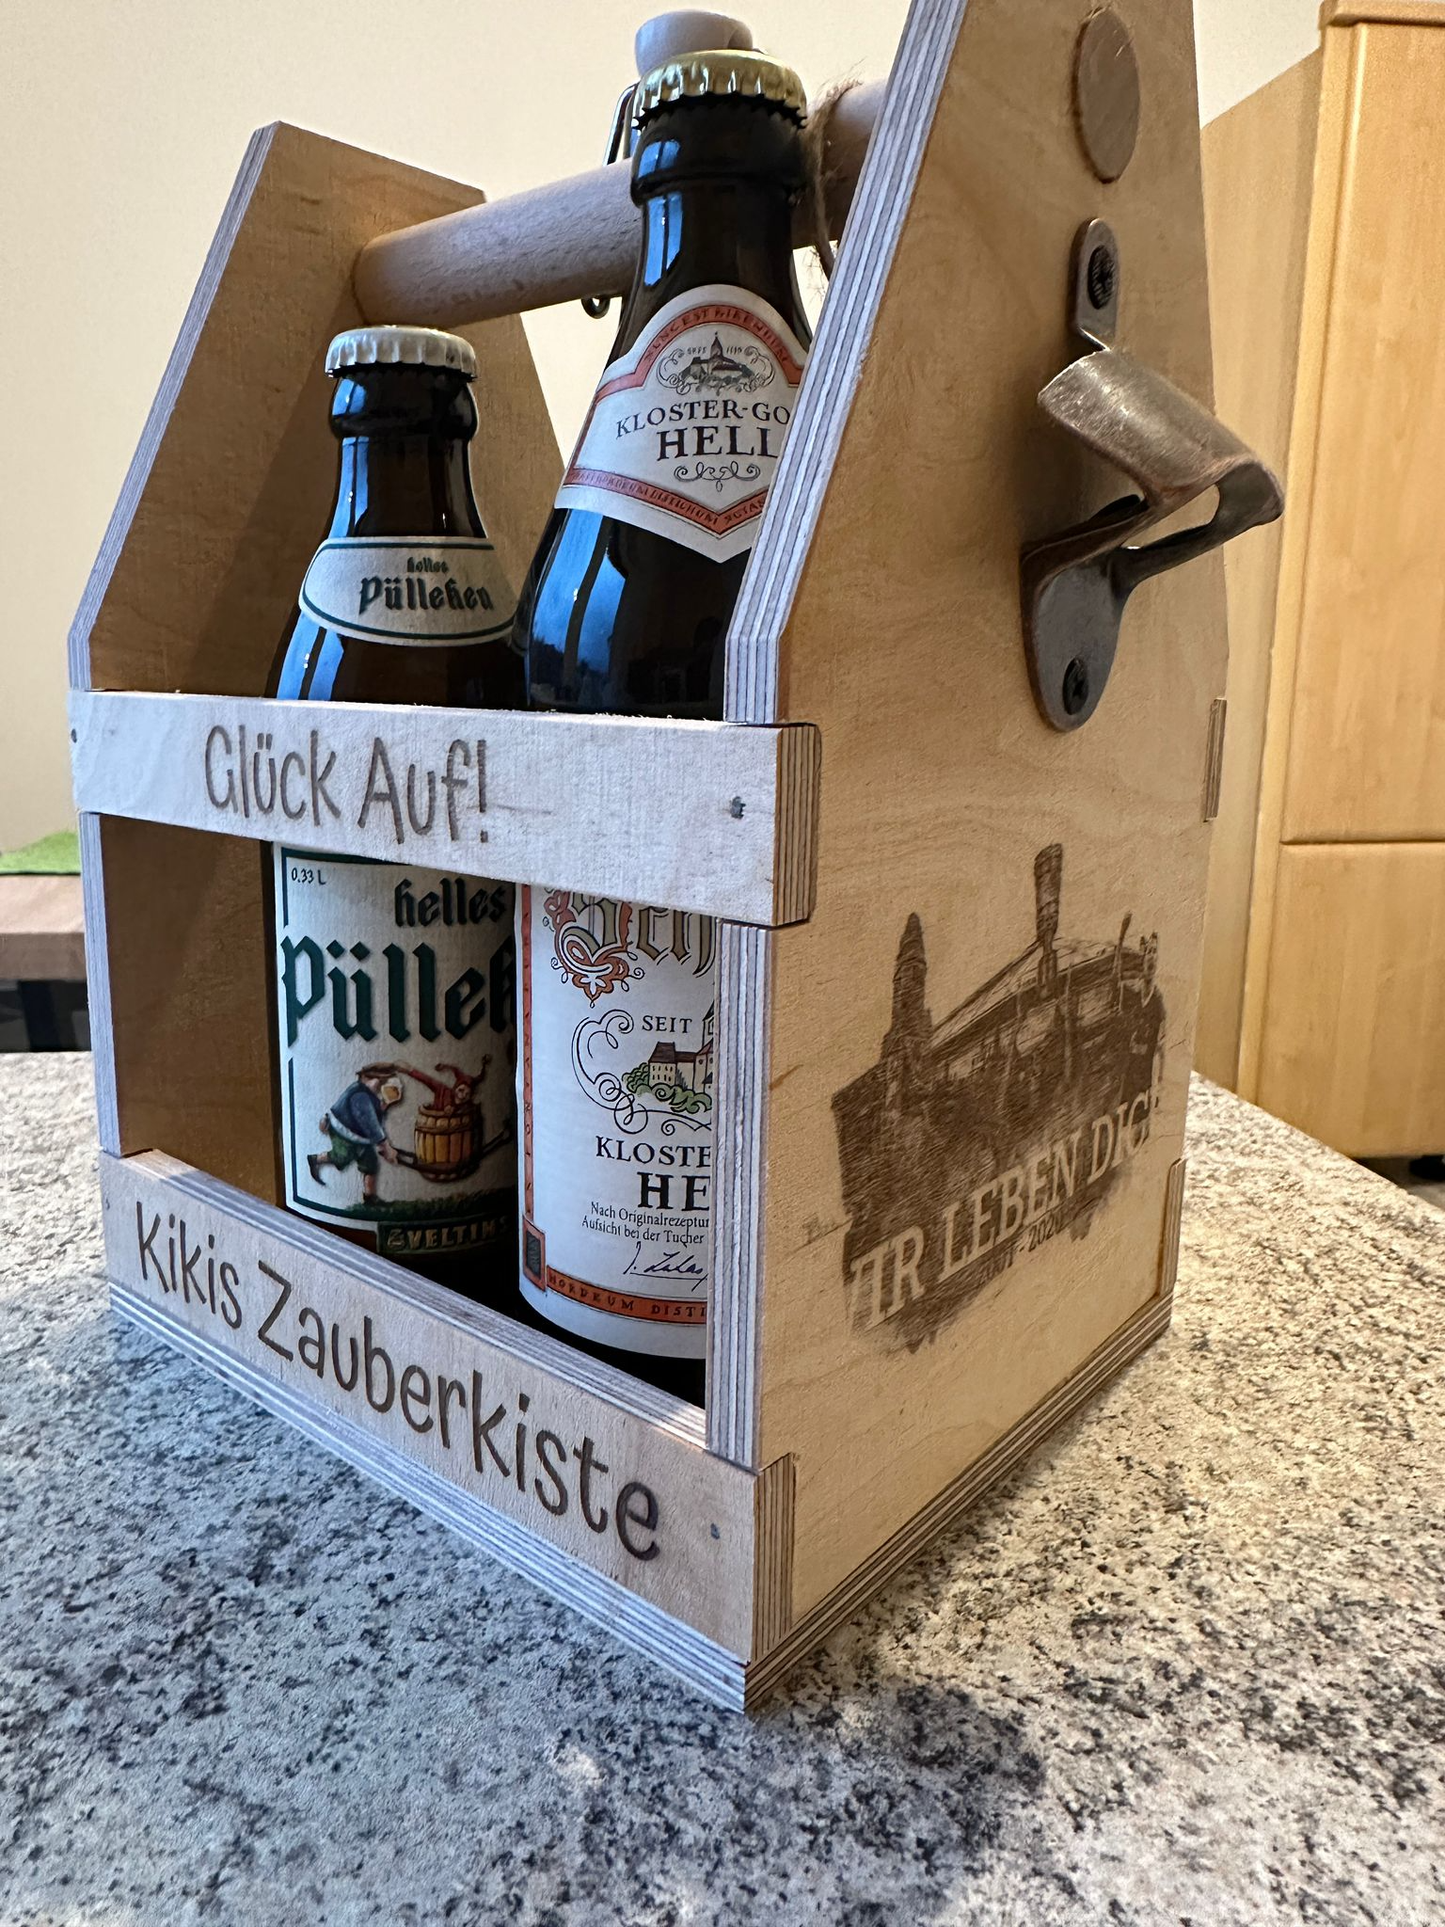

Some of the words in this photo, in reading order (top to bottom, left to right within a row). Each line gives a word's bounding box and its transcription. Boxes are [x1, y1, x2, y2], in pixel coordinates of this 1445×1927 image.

[204, 723, 342, 827] Glück
[356, 736, 489, 845] Auf!
[394, 877, 508, 928] helles
[641, 1014, 693, 1034] SEIT
[595, 1135, 711, 1169] KLOSTE
[590, 1200, 617, 1219] Nach
[636, 1171, 711, 1212] HE
[936, 1129, 1082, 1283] LEBEN
[581, 1214, 622, 1238] Aufsicht
[623, 1224, 640, 1240] bei
[642, 1224, 661, 1243] der
[135, 1200, 243, 1330] Kikis
[257, 1258, 661, 1562] Zauberkiste
